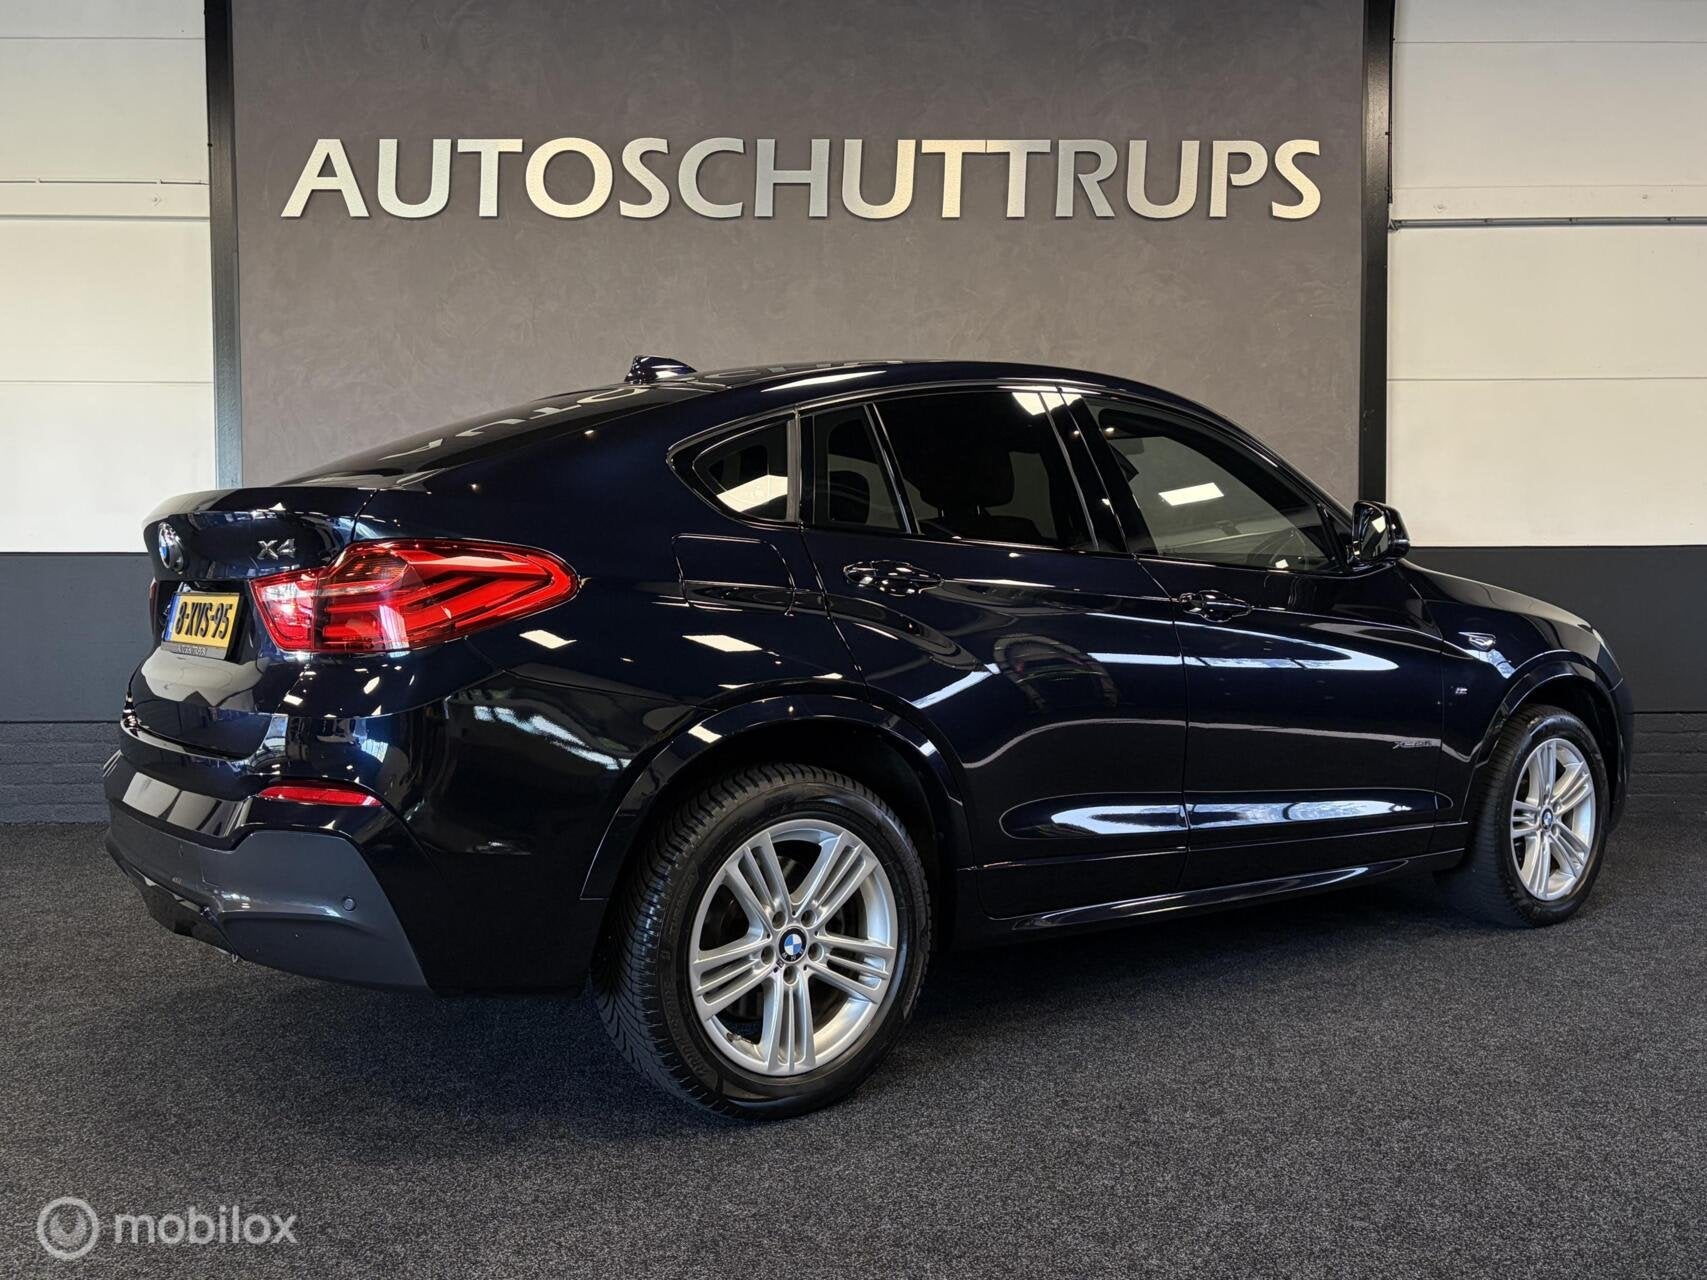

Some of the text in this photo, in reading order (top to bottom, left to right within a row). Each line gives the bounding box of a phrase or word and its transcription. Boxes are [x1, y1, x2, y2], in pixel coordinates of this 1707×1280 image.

[281, 137, 1321, 219] AUTOSCHUTTRUPS
[257, 538, 296, 561] X4
[175, 601, 233, 640] 8-XVS-95
